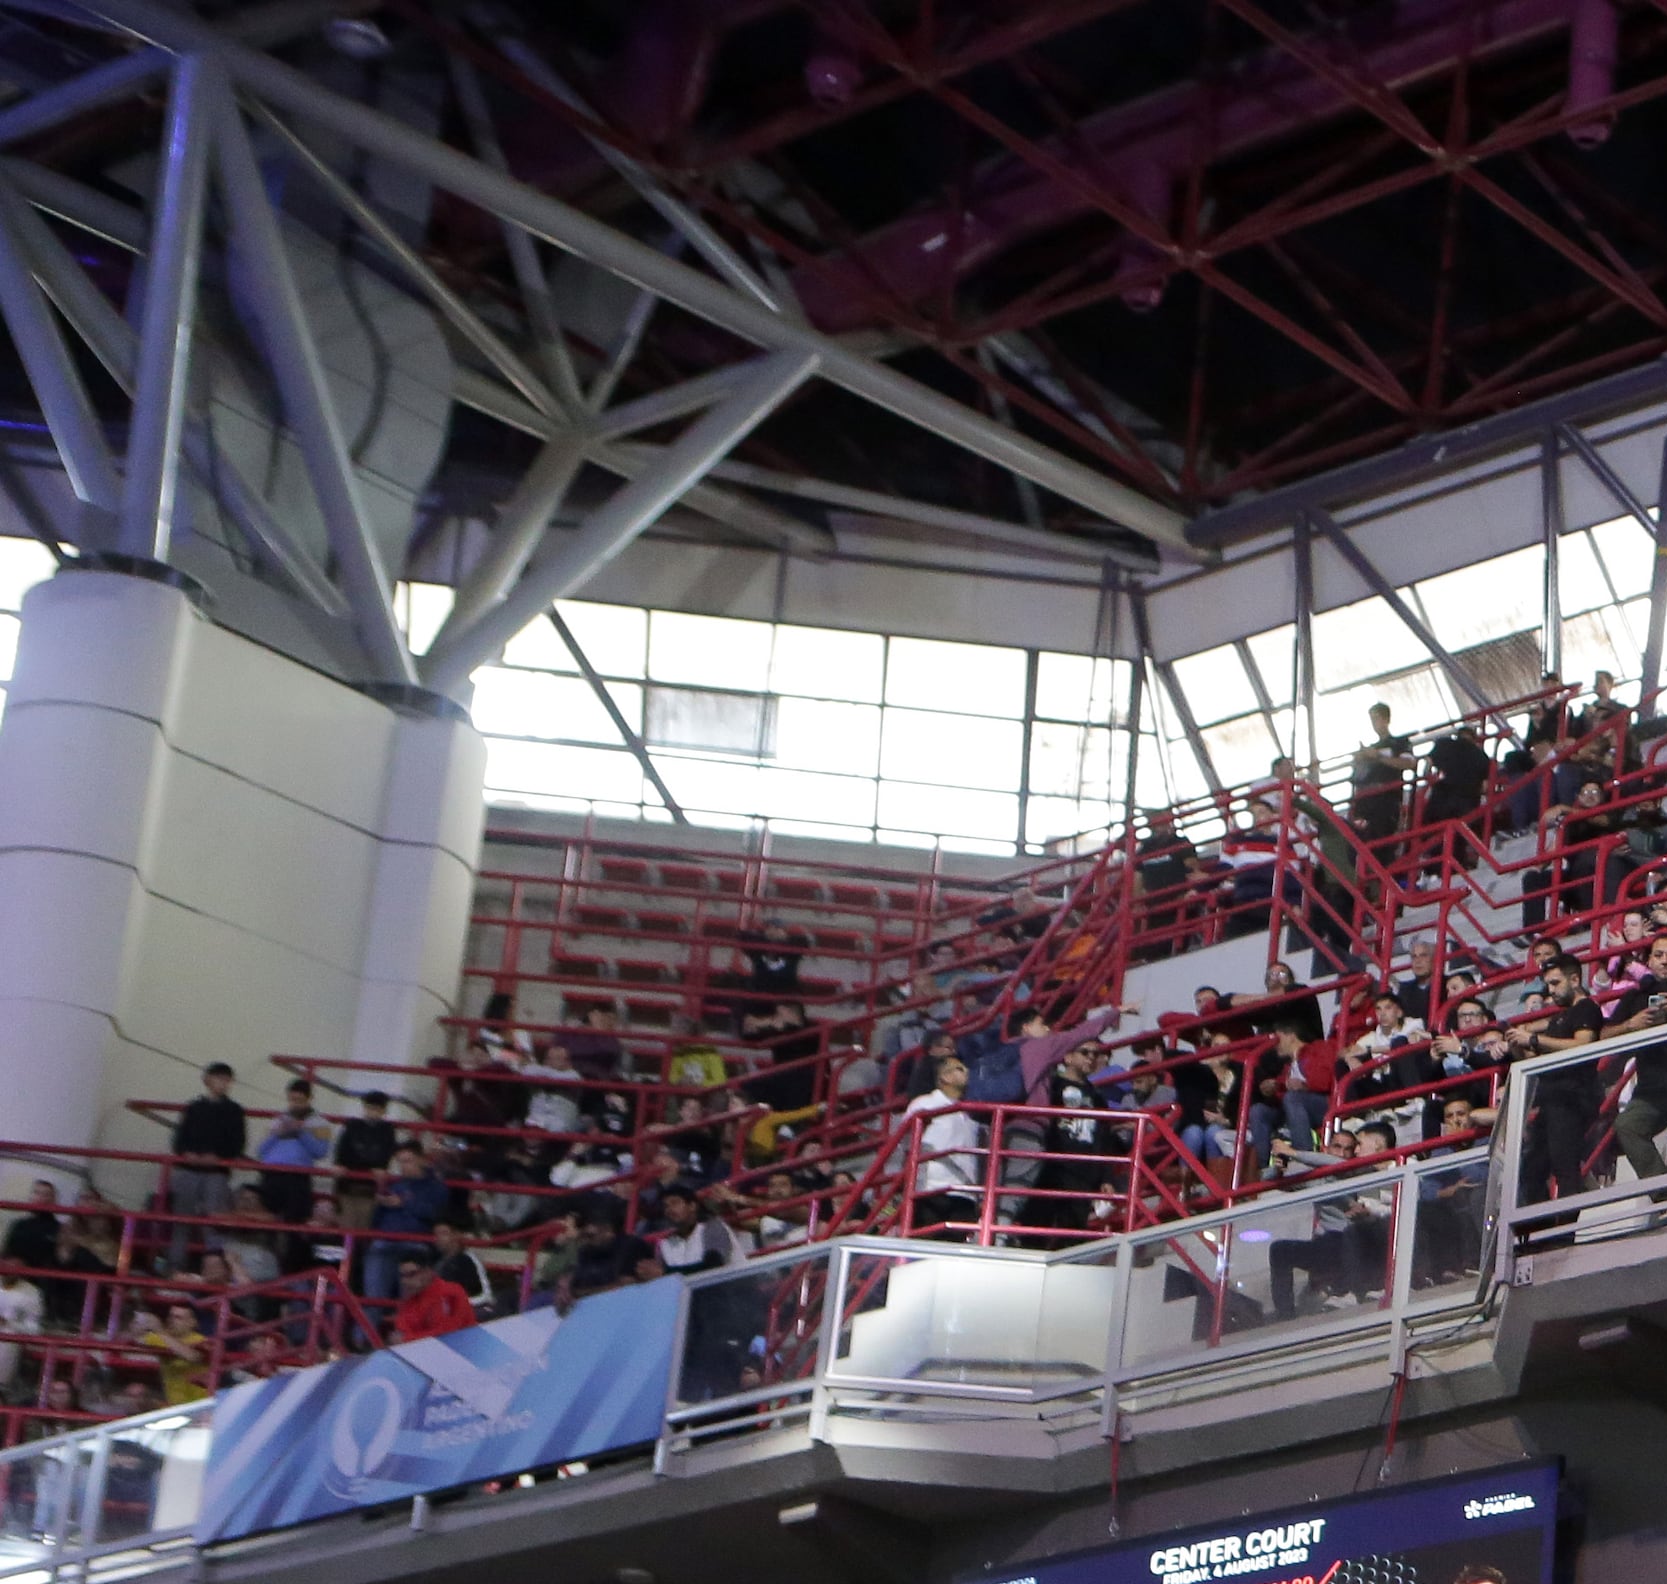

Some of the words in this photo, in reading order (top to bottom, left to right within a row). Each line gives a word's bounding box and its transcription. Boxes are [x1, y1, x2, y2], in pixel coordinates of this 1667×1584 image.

[1150, 1536, 1241, 1575] CENTER
[1246, 1518, 1326, 1556] COURT
[1213, 1567, 1223, 1578] 4
[1223, 1554, 1277, 1576] AUGUST
[1278, 1547, 1308, 1566] 2023
